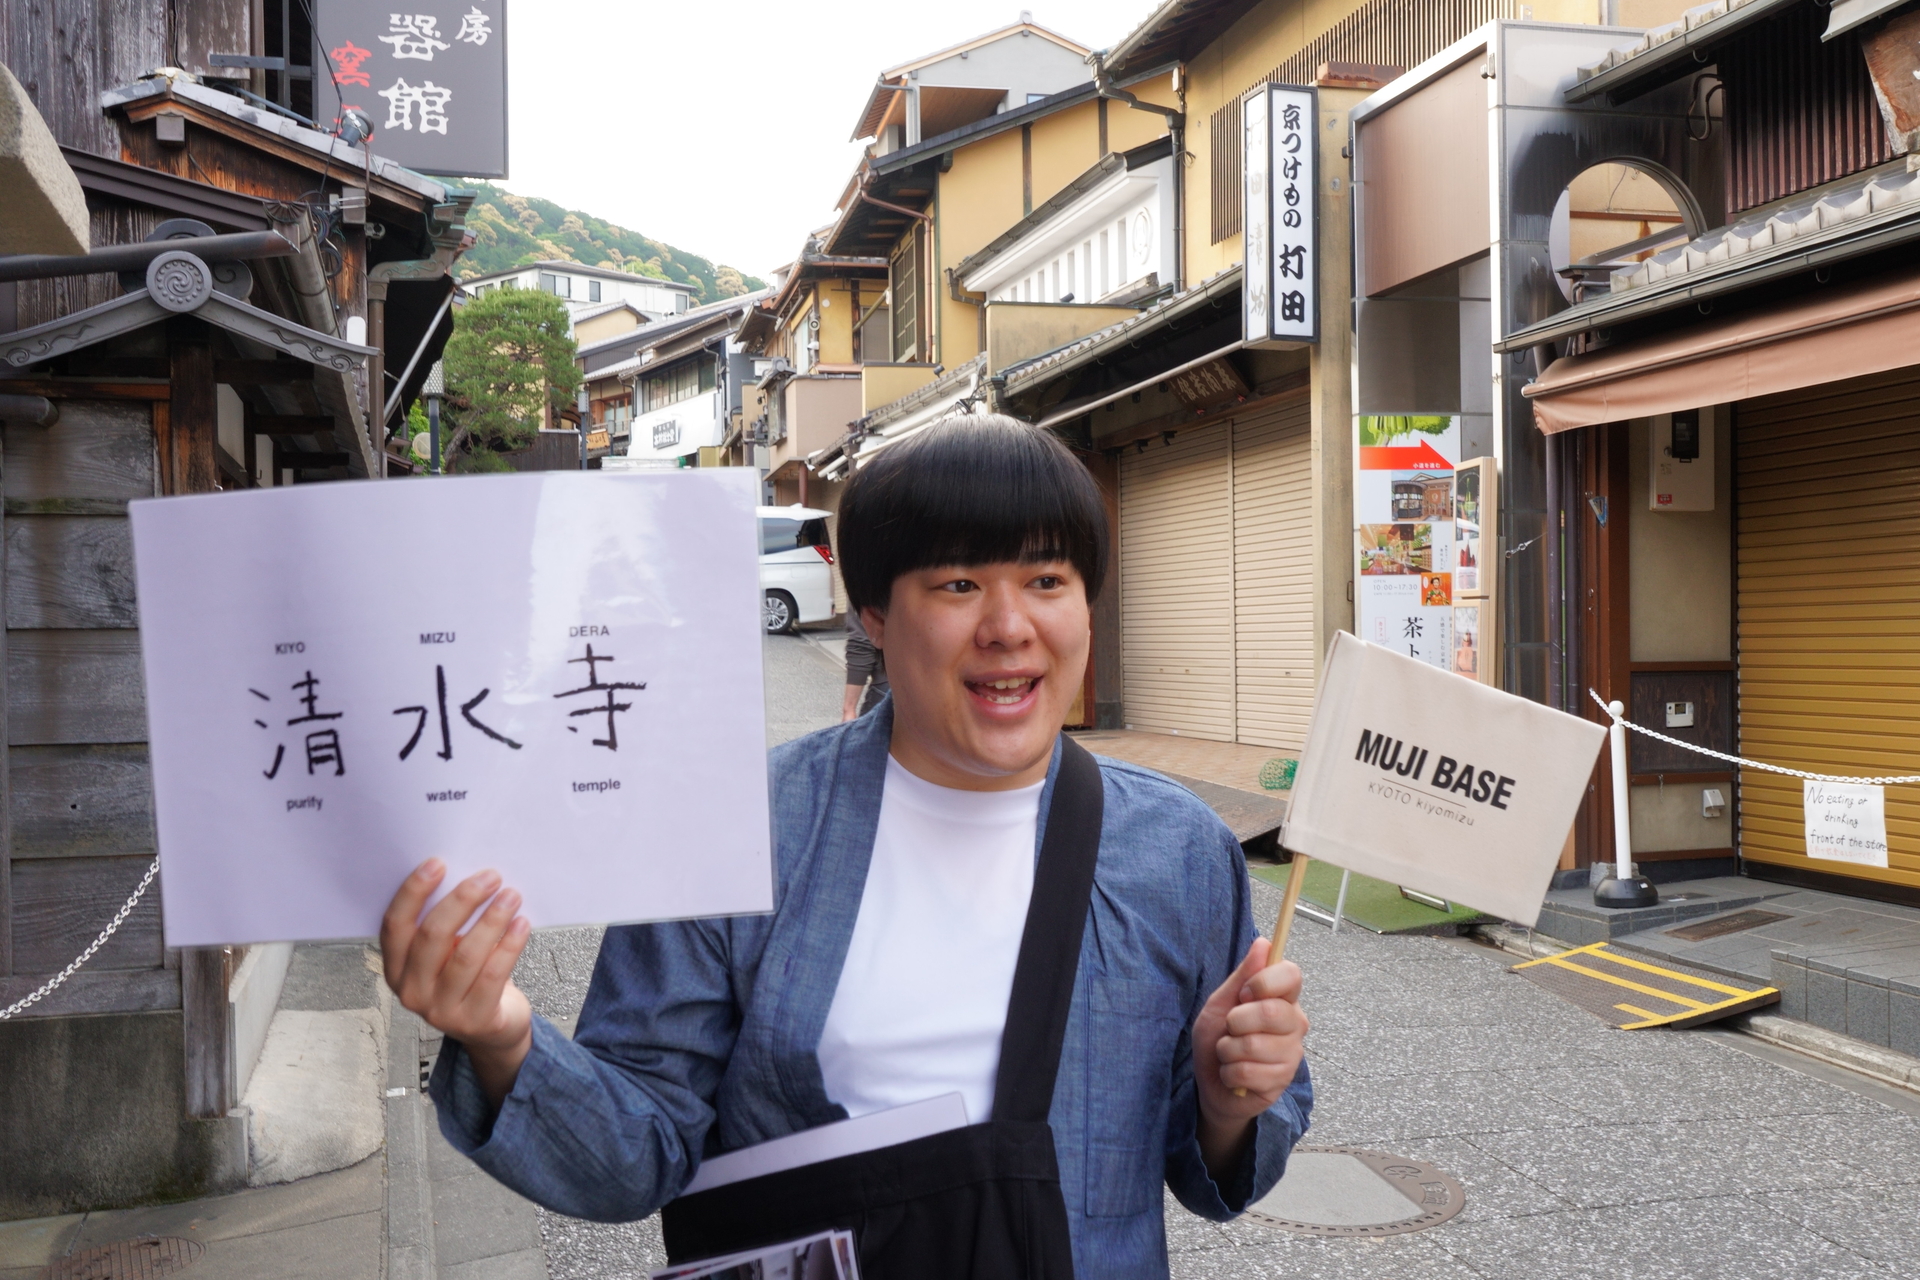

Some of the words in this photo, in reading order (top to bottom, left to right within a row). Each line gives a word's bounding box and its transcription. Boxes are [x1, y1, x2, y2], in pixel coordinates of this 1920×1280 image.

[455, 0, 493, 46] 房
[331, 40, 374, 143] 窯
[1281, 104, 1303, 229] 京つけもの
[1279, 243, 1307, 324] 打田
[275, 641, 306, 655] KIYO
[419, 631, 456, 645] MIZU
[569, 625, 611, 638] DERA
[1355, 728, 1429, 781] MUJI
[1430, 754, 1517, 811] BASE
[286, 796, 323, 812] purify
[426, 789, 468, 803] water
[572, 778, 621, 793] temple
[1368, 781, 1412, 805] KYOTO
[1416, 797, 1476, 827] kiyomizu
[1806, 786, 1824, 804] No
[1826, 794, 1855, 809] eating
[1858, 797, 1868, 805] or
[1810, 829, 1835, 845] front
[1835, 835, 1846, 846] of
[1849, 837, 1863, 848] the
[1865, 839, 1888, 852] store
